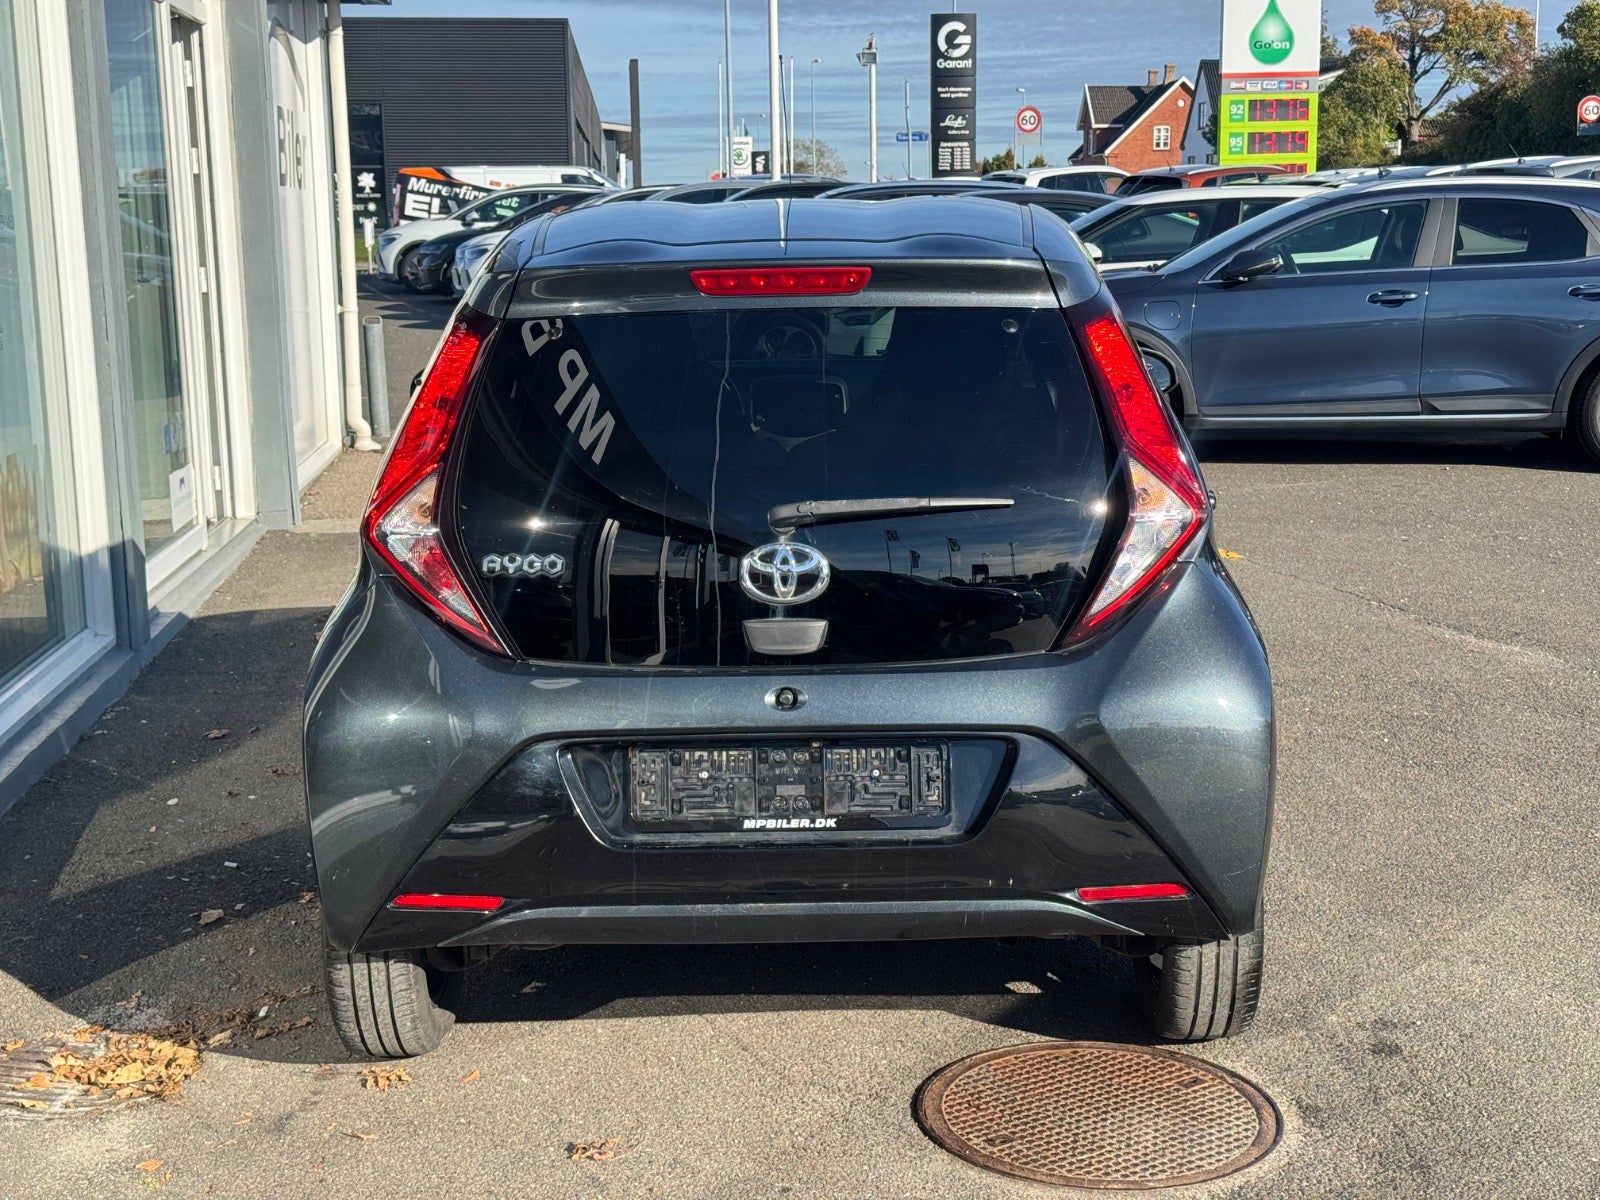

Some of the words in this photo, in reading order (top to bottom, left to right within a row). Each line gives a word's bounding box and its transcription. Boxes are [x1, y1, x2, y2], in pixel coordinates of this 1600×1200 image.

[936, 59, 973, 69] Garant
[1230, 104, 1244, 114] 92
[1586, 105, 1600, 116] 60
[1021, 115, 1037, 126] 60
[277, 105, 307, 190] Biler
[1229, 137, 1243, 147] 95
[481, 553, 566, 577] AYGO
[743, 817, 838, 830] MPBILER.DK
